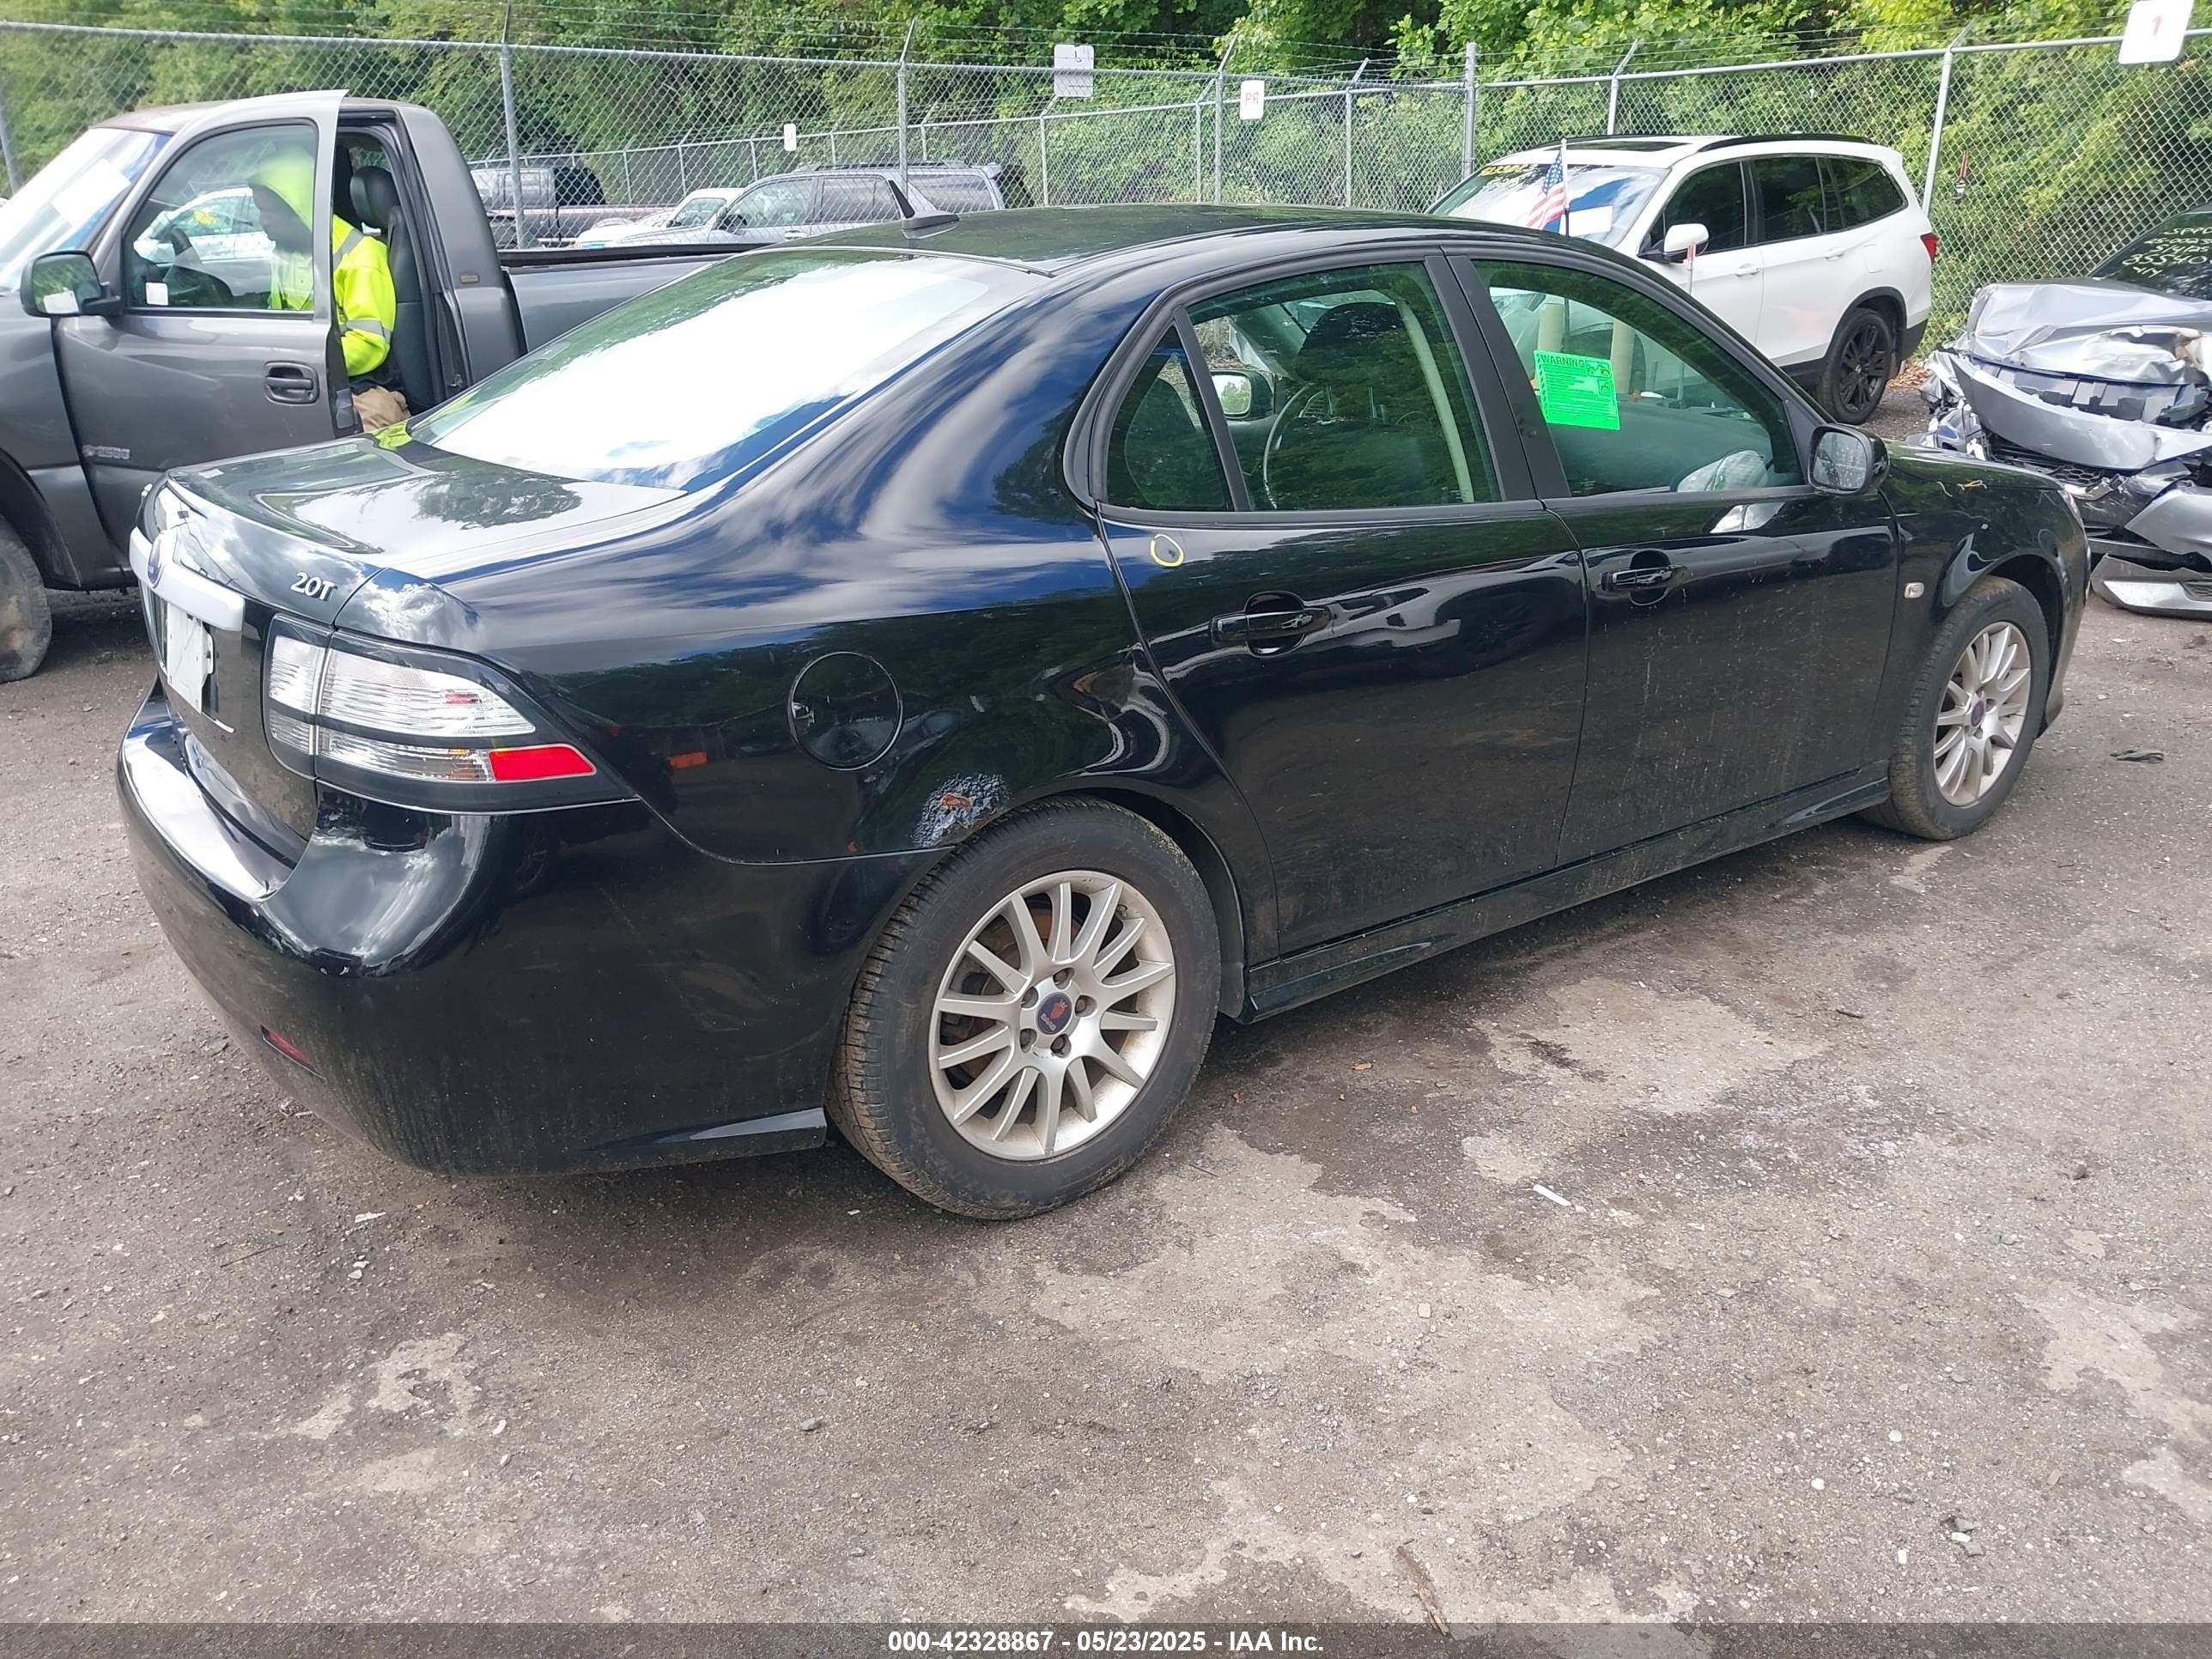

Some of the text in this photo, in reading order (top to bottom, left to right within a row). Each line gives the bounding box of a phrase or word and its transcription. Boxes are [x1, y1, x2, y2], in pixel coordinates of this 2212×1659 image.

[2151, 14, 2163, 36] 1
[1245, 91, 1260, 105] PR
[1540, 354, 1585, 368] WARNING
